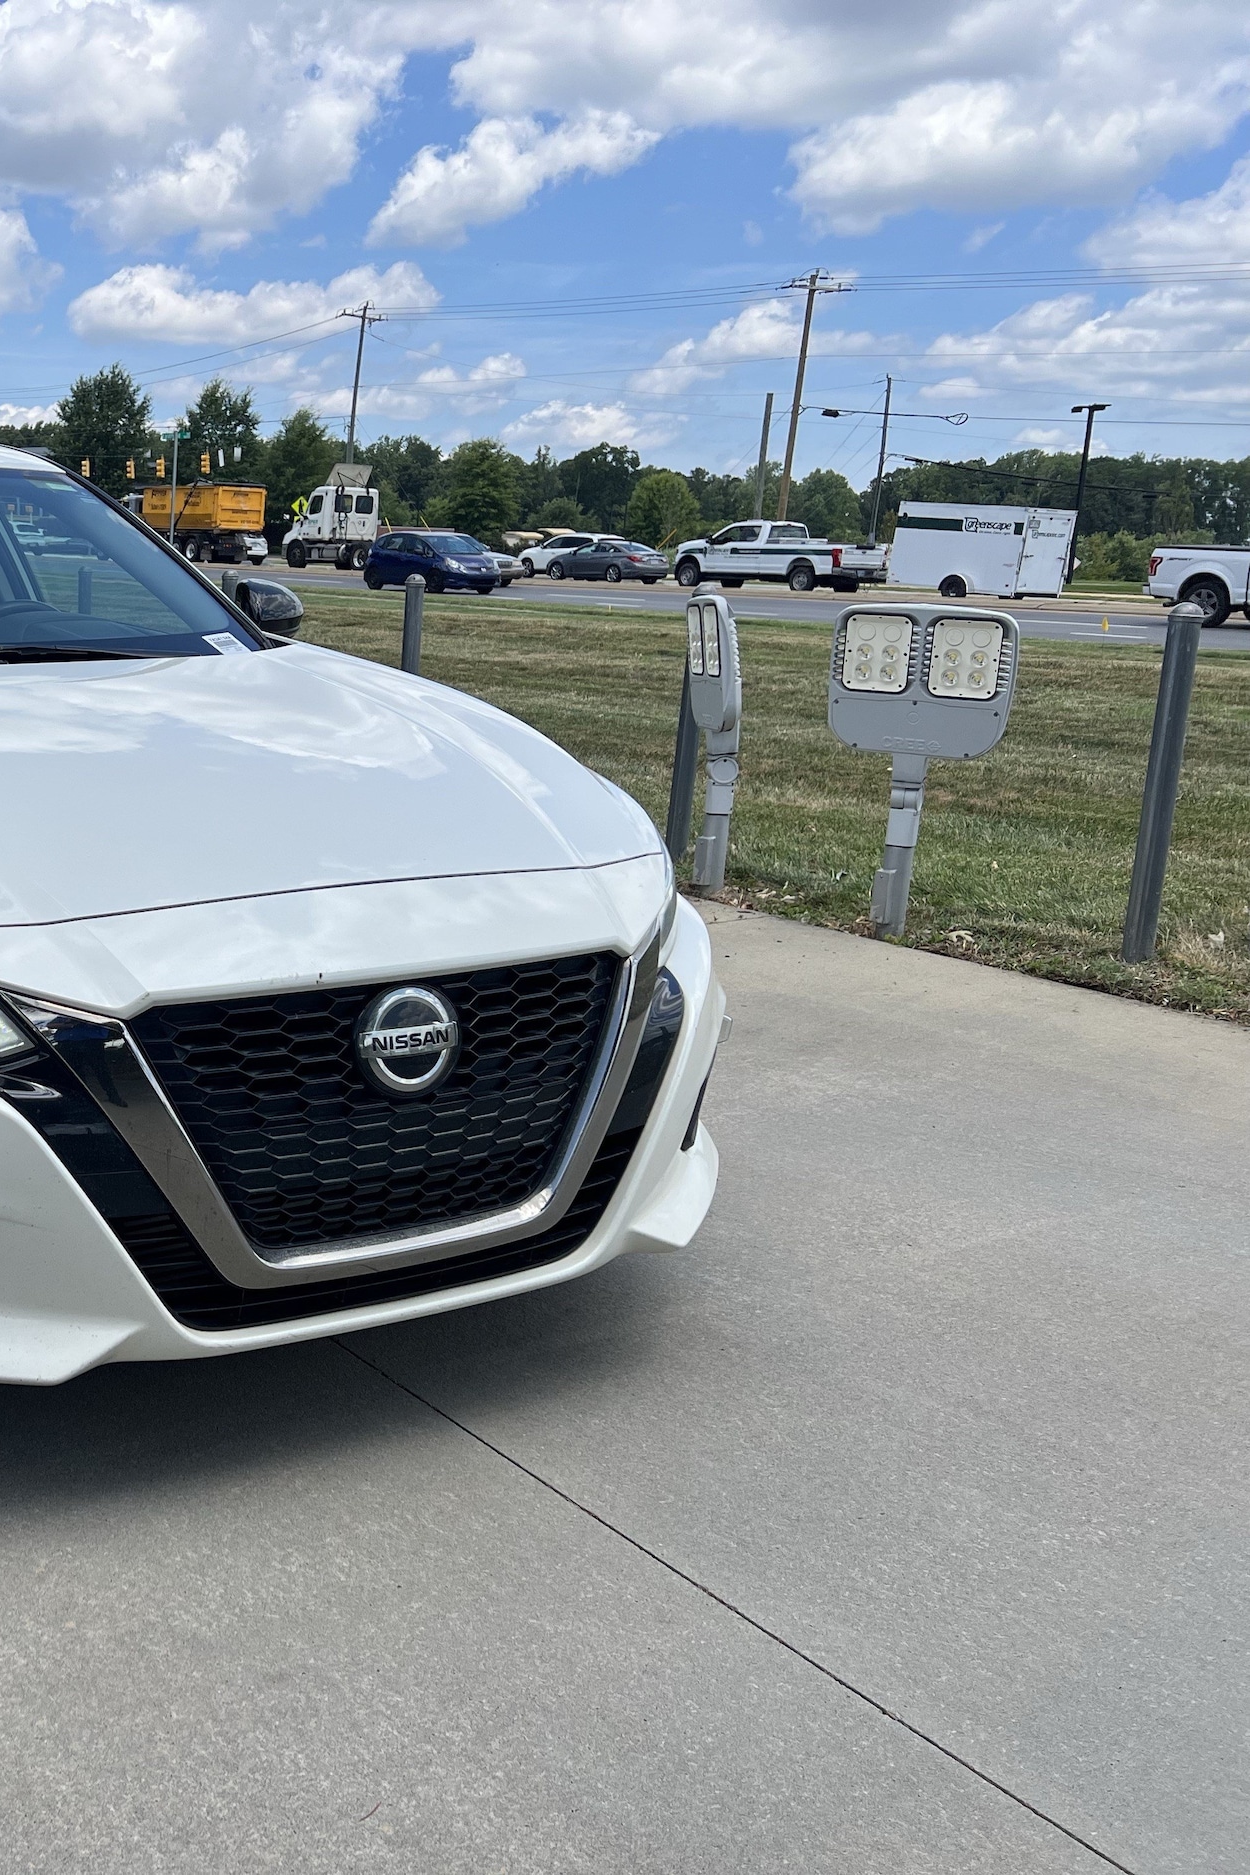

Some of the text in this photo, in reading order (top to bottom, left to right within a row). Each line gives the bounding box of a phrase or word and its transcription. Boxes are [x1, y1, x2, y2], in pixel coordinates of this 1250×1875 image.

[965, 517, 1012, 532] greenscape
[881, 735, 926, 751] CREE
[372, 1028, 449, 1052] NISSAN
